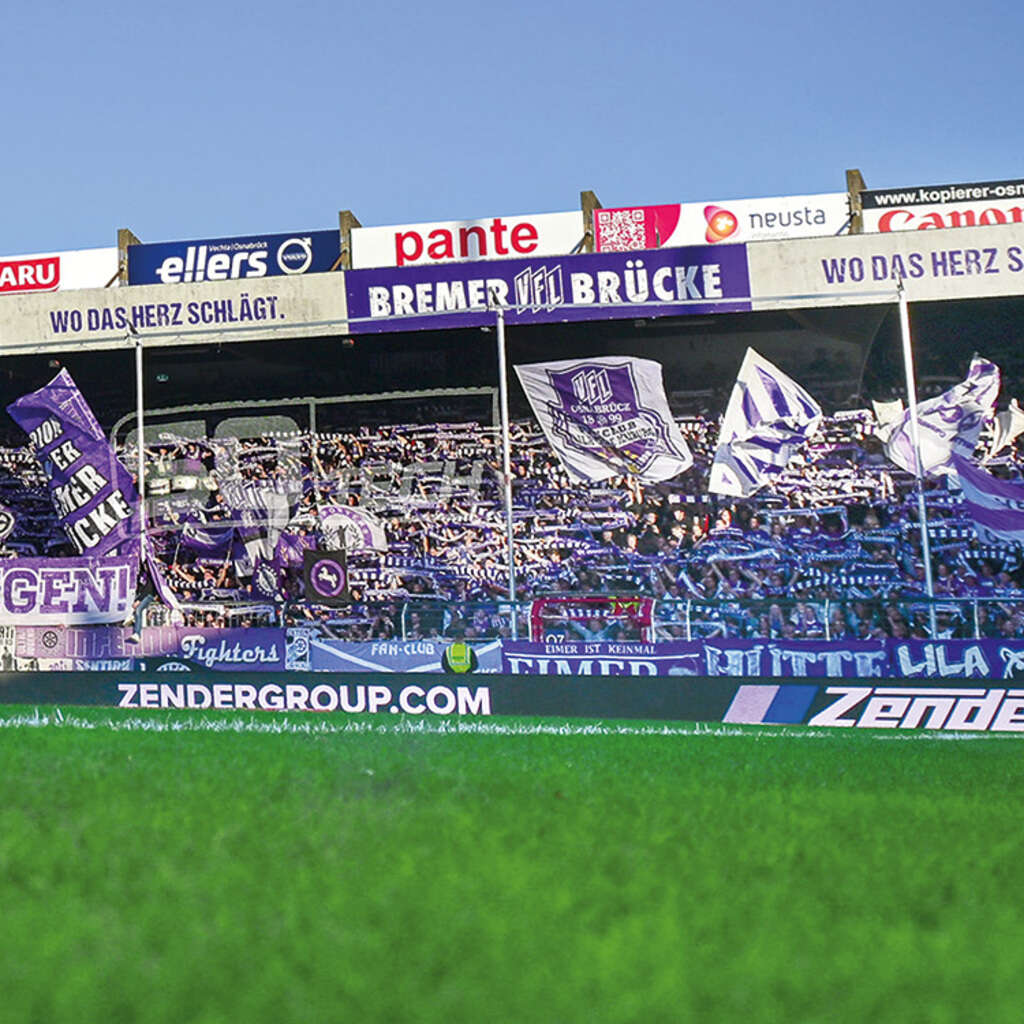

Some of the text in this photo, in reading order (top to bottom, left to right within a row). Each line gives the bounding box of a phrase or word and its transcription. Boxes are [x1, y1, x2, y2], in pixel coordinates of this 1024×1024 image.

[749, 206, 826, 229] neusta
[394, 218, 539, 267] pante
[156, 245, 268, 284] ellers
[821, 257, 865, 284] WO
[871, 252, 925, 280] DAS
[931, 247, 999, 278] HERZ
[369, 278, 509, 317] BREMER
[570, 259, 724, 304] BRÜCKE
[50, 293, 286, 333] WO DAS HERZ SCHLÄGT.
[182, 636, 280, 663] Fighters
[545, 644, 656, 655] EIMER IST KEINMAL
[898, 643, 990, 677] LILA
[117, 683, 491, 716] ZENDERGROUP.COM
